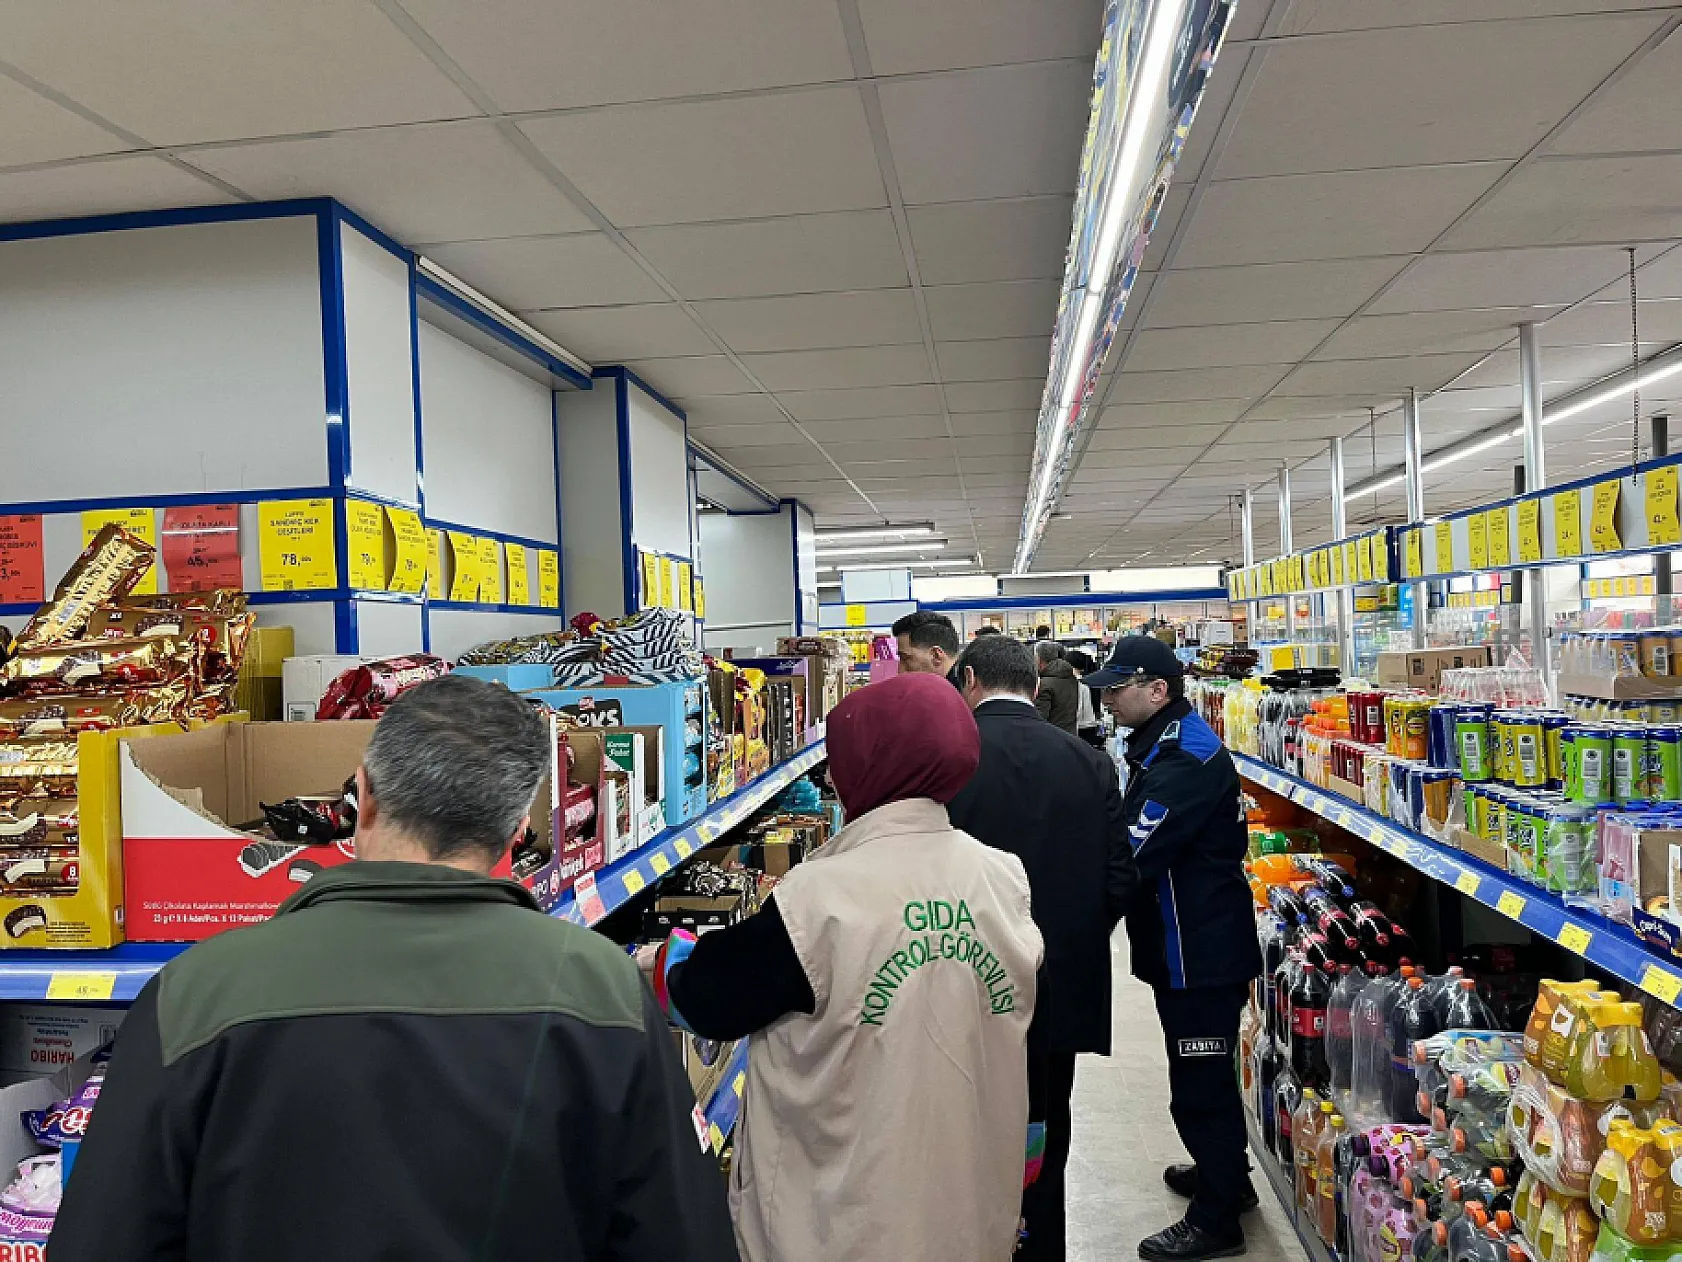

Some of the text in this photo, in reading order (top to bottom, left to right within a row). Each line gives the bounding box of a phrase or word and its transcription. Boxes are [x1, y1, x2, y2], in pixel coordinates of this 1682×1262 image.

[904, 899, 976, 932] GIDA
[859, 936, 939, 1026] KONTROL
[30, 1050, 75, 1064] HARIBO
